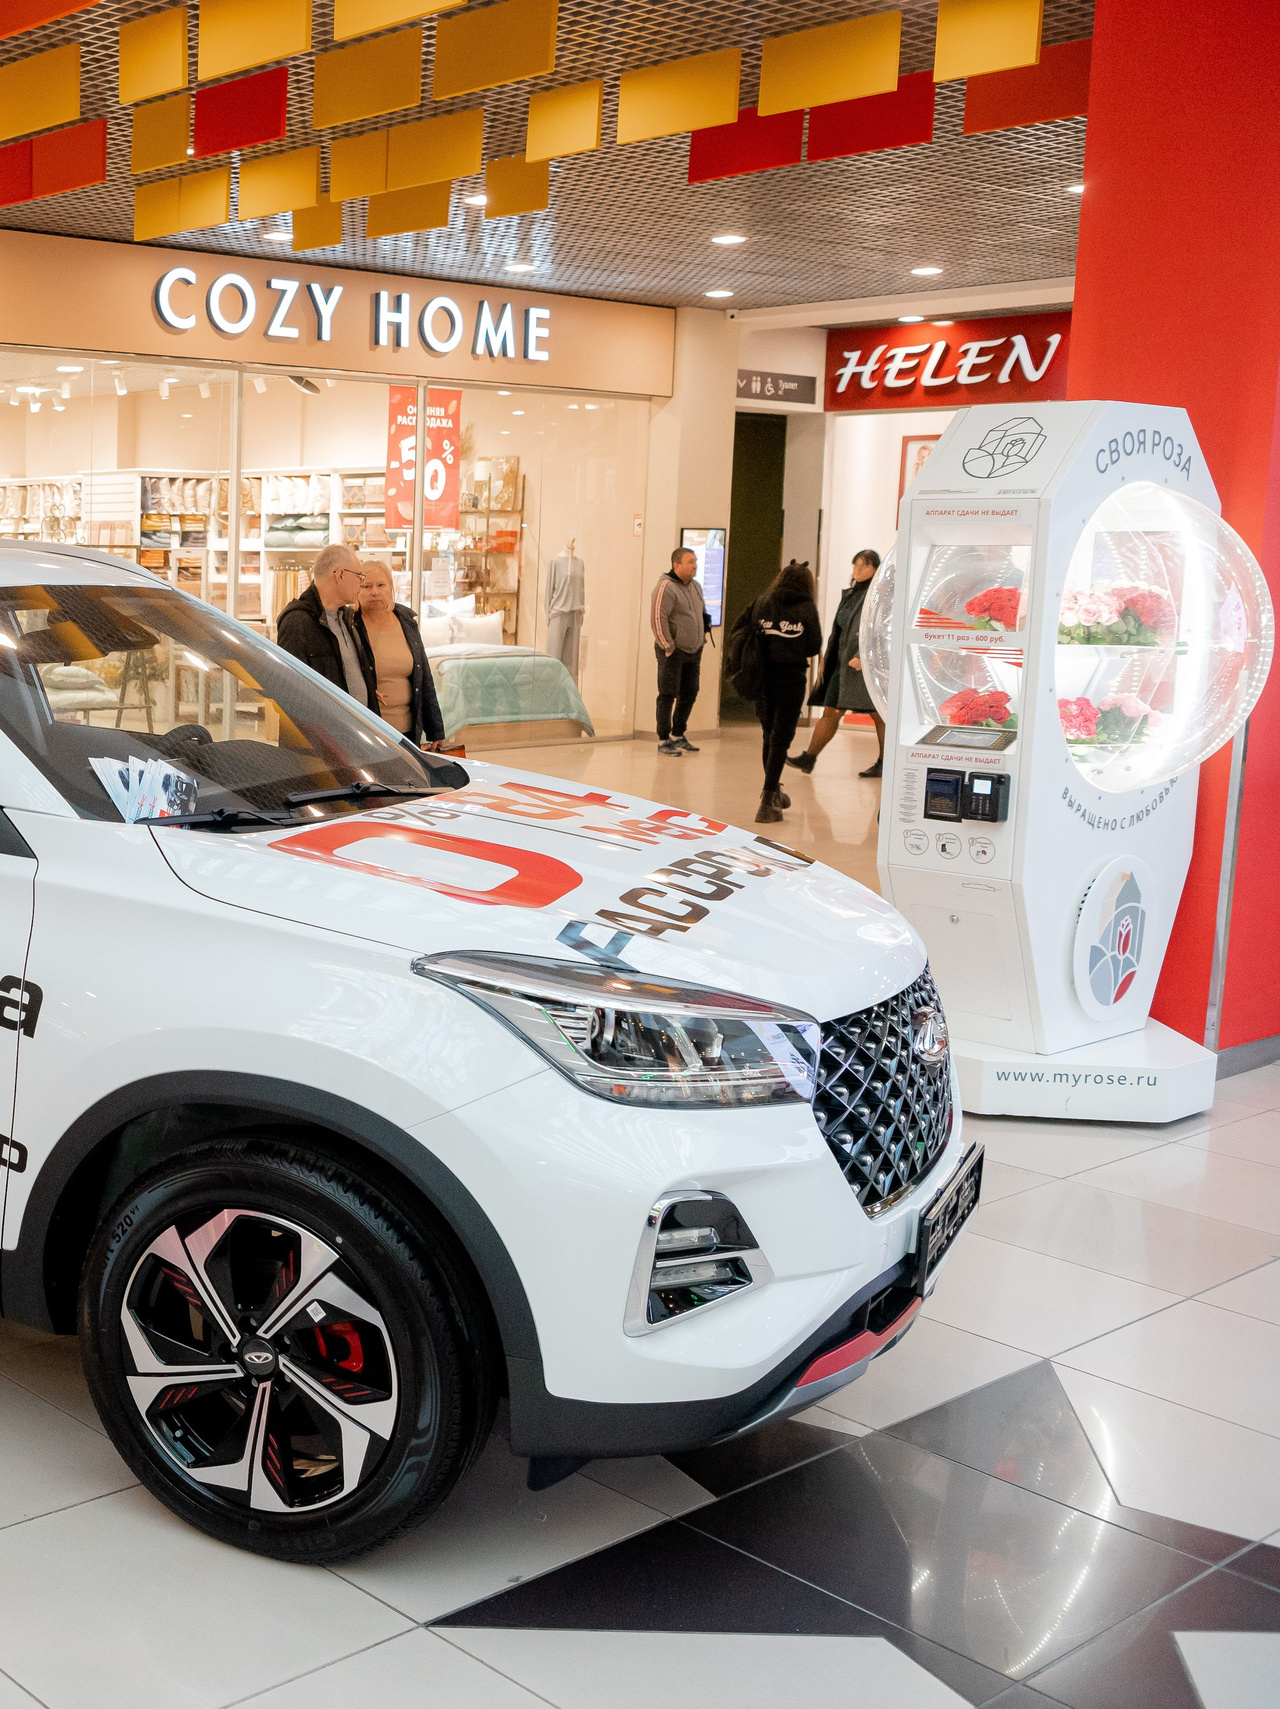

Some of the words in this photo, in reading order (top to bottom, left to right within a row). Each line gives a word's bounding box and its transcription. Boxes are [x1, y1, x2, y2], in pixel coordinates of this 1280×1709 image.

[155, 267, 344, 341] COZY
[375, 290, 551, 361] HOME
[835, 333, 1064, 395] HELEN
[397, 415, 453, 429] РАСПОДАЖА
[407, 404, 445, 416] ОНЯЯ
[1095, 429, 1147, 474] СВОЯ
[1151, 436, 1193, 481] РОЗА
[779, 620, 805, 632] York
[1061, 786, 1118, 831] ВЫРАЩЕНО
[996, 1068, 1158, 1088] www.myrose.ru
[111, 1215, 134, 1244] 520
